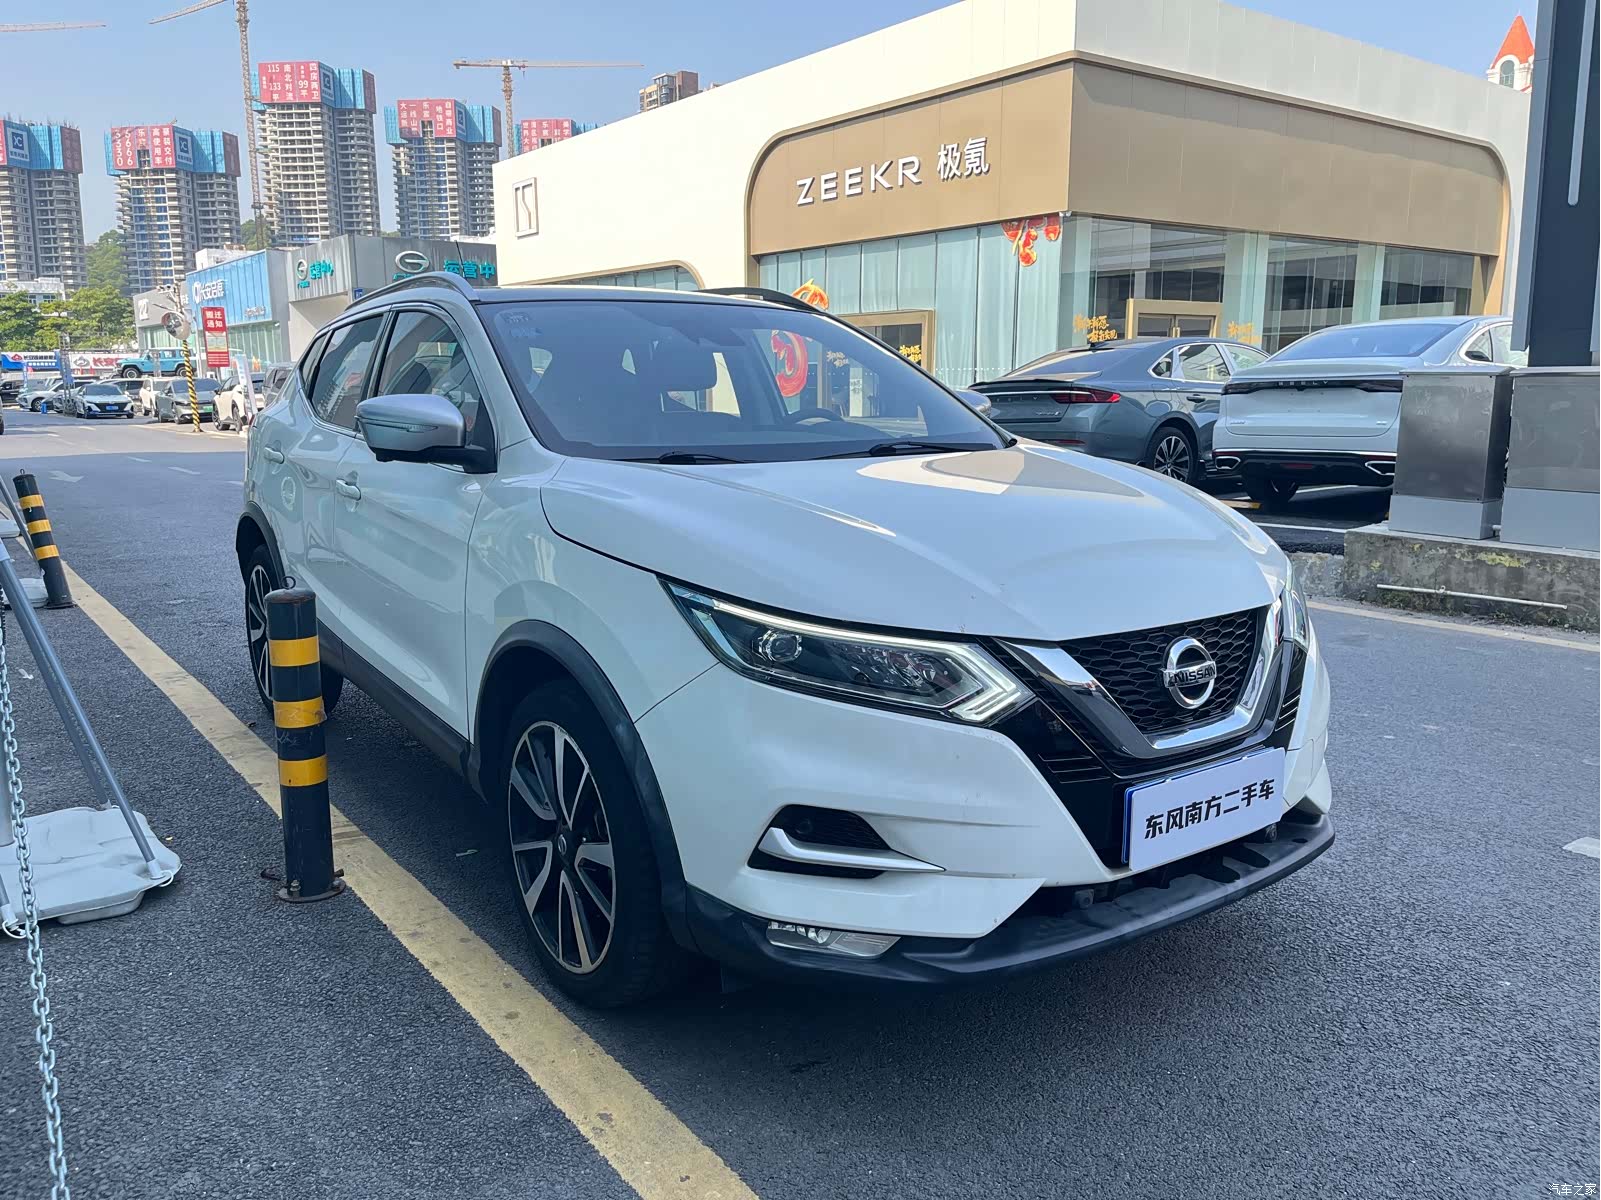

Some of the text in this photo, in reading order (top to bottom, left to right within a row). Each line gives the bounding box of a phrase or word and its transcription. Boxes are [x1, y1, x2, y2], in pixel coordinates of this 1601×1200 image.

[796, 156, 922, 206] ZEEKR
[937, 136, 990, 181] 极氪
[206, 319, 223, 328] 通知
[1174, 663, 1216, 684] NISSAN
[1144, 778, 1276, 840] 东风南方二手车
